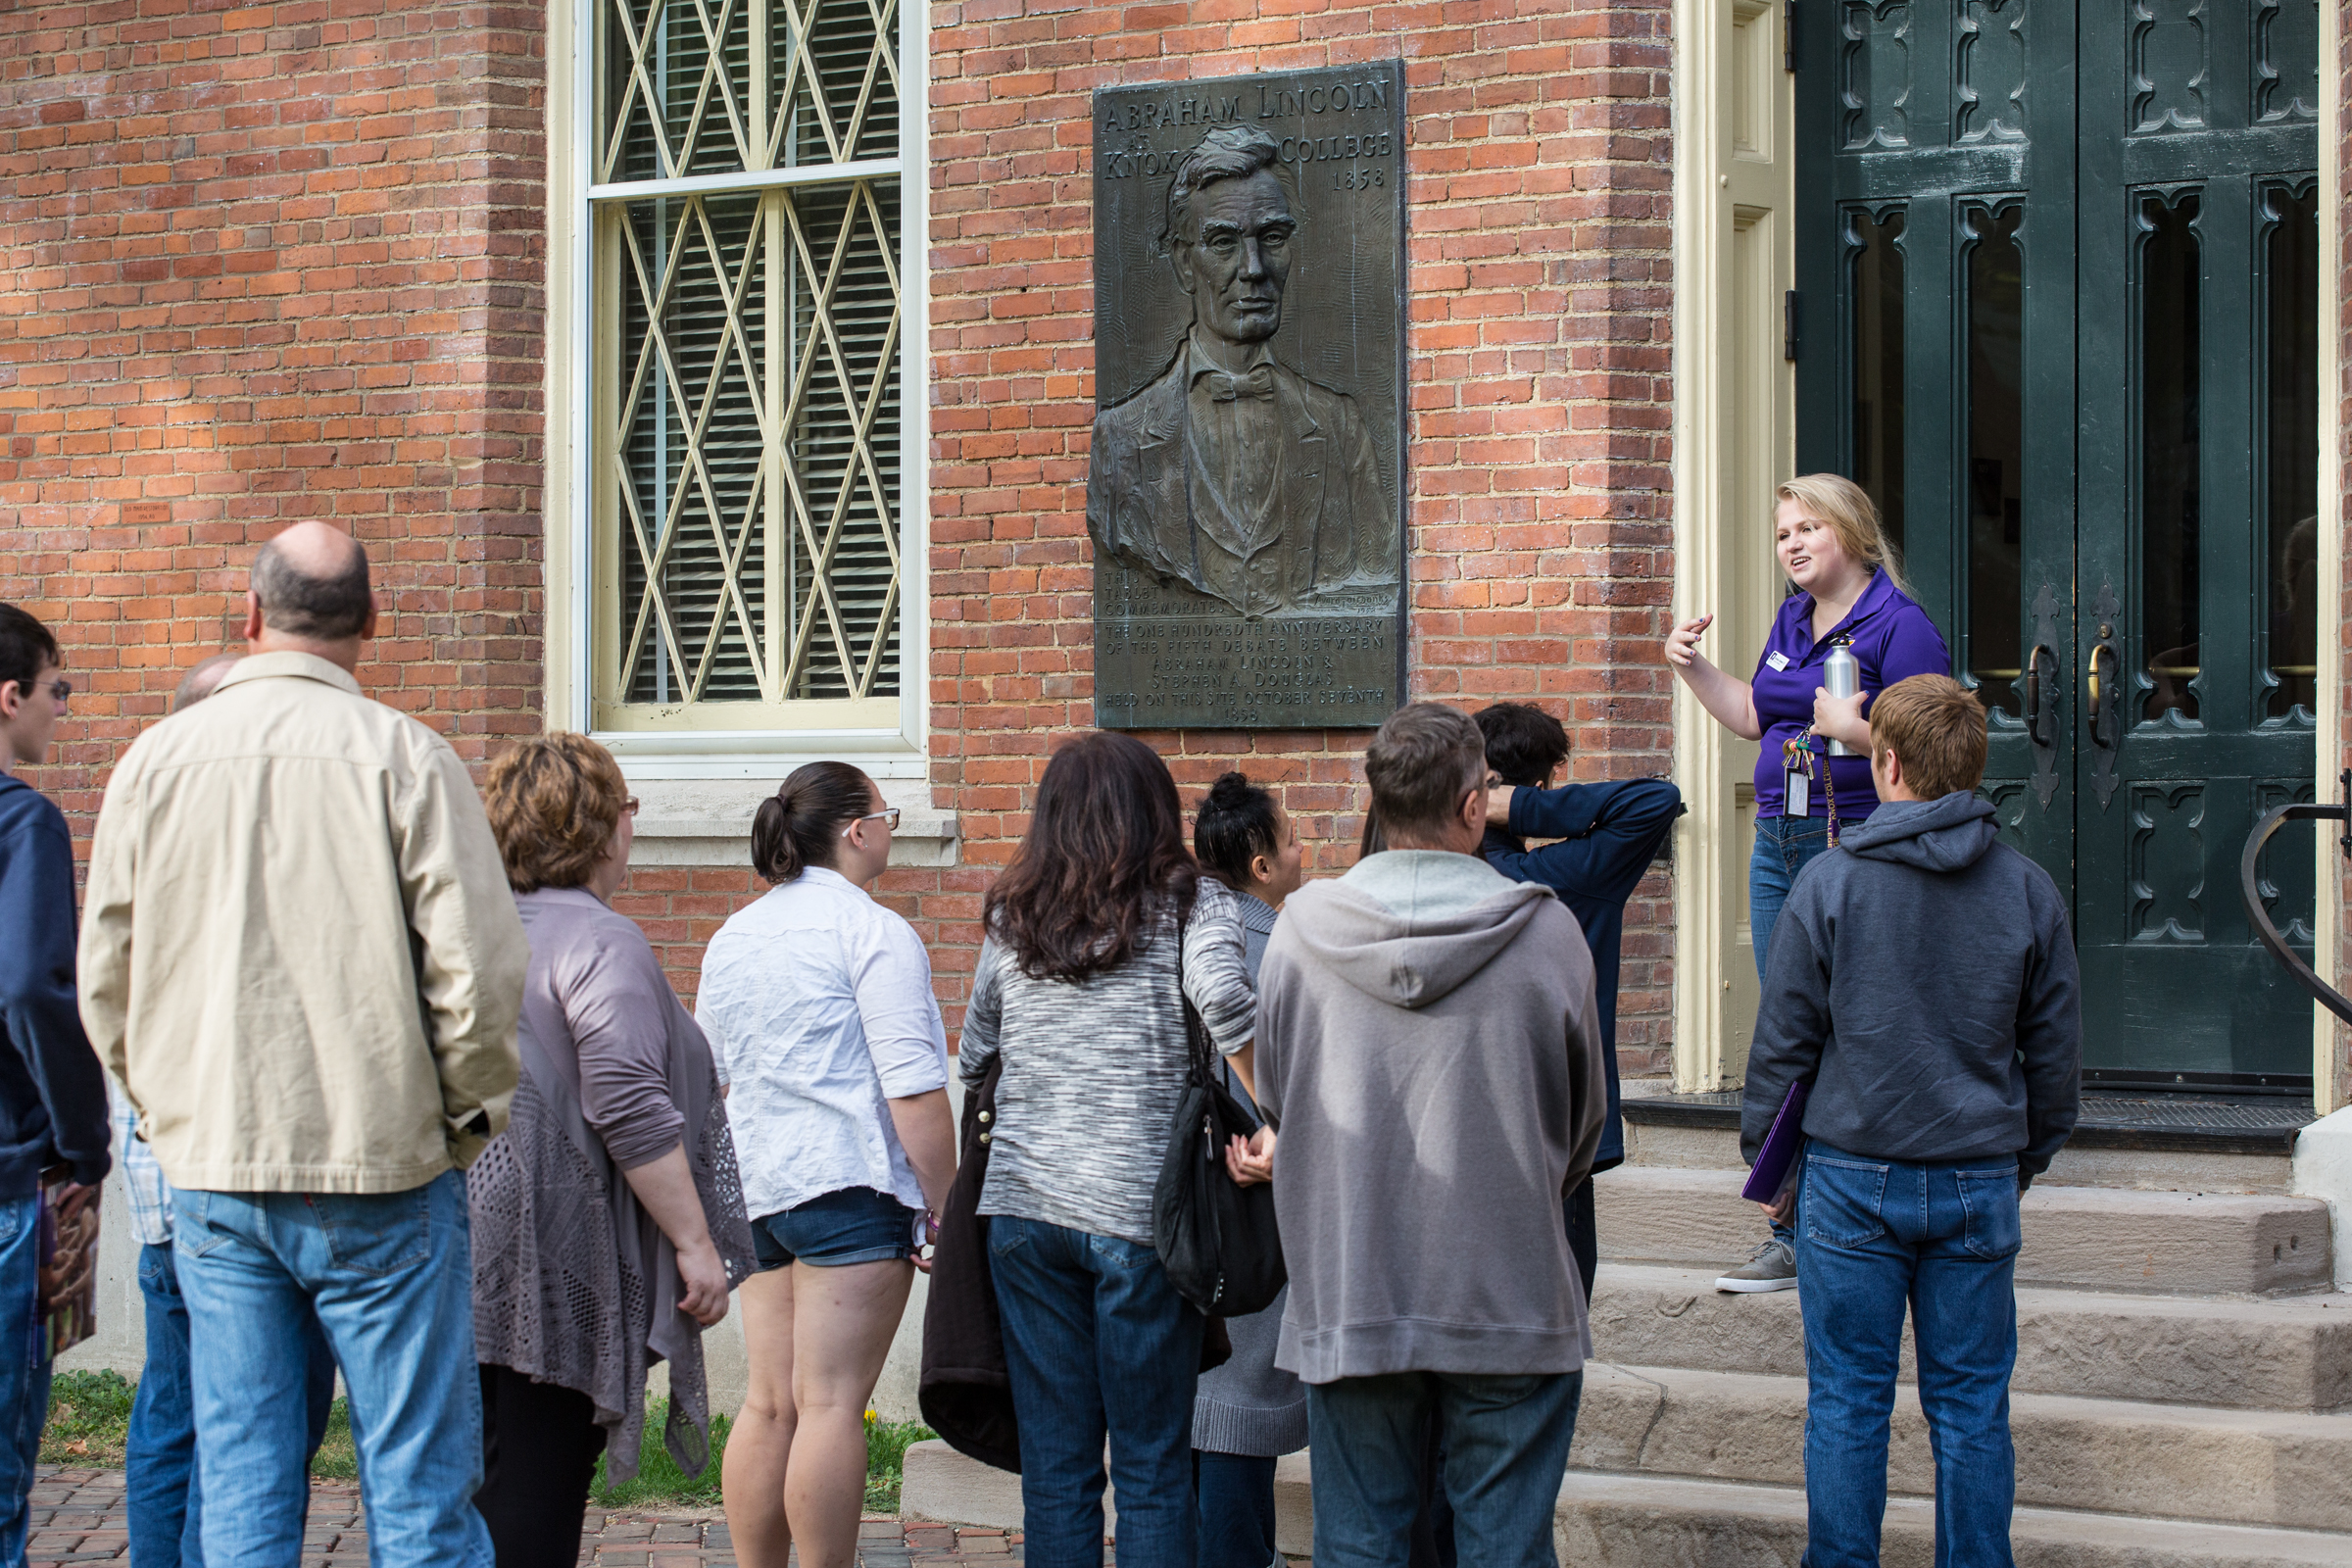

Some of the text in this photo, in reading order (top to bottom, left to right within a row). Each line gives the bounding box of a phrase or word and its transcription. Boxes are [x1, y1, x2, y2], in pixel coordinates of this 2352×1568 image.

[1102, 79, 1390, 132] ABRAHAM LINCOLN
[1127, 133, 1150, 150] AT
[1103, 132, 1393, 180] KNOX COLLEGE
[1332, 168, 1384, 190] 1858
[1104, 570, 1140, 585] THIS
[1104, 586, 1159, 600] TABLET
[1104, 600, 1225, 616] COMMEMORATES
[1105, 618, 1384, 639] THE ONE HUNDREDTH ANNIVERSARY
[1105, 635, 1384, 655] OF THE FIFTH DEBATE BETWEEN
[1152, 654, 1334, 671] ABRAHAM LINCOLN &
[1152, 671, 1334, 689] STEPHEN A. DOUGLAS
[1105, 689, 1385, 708] HELD ON THIS SITE OCTOBER SEVENTH
[1224, 707, 1260, 722] 1858
